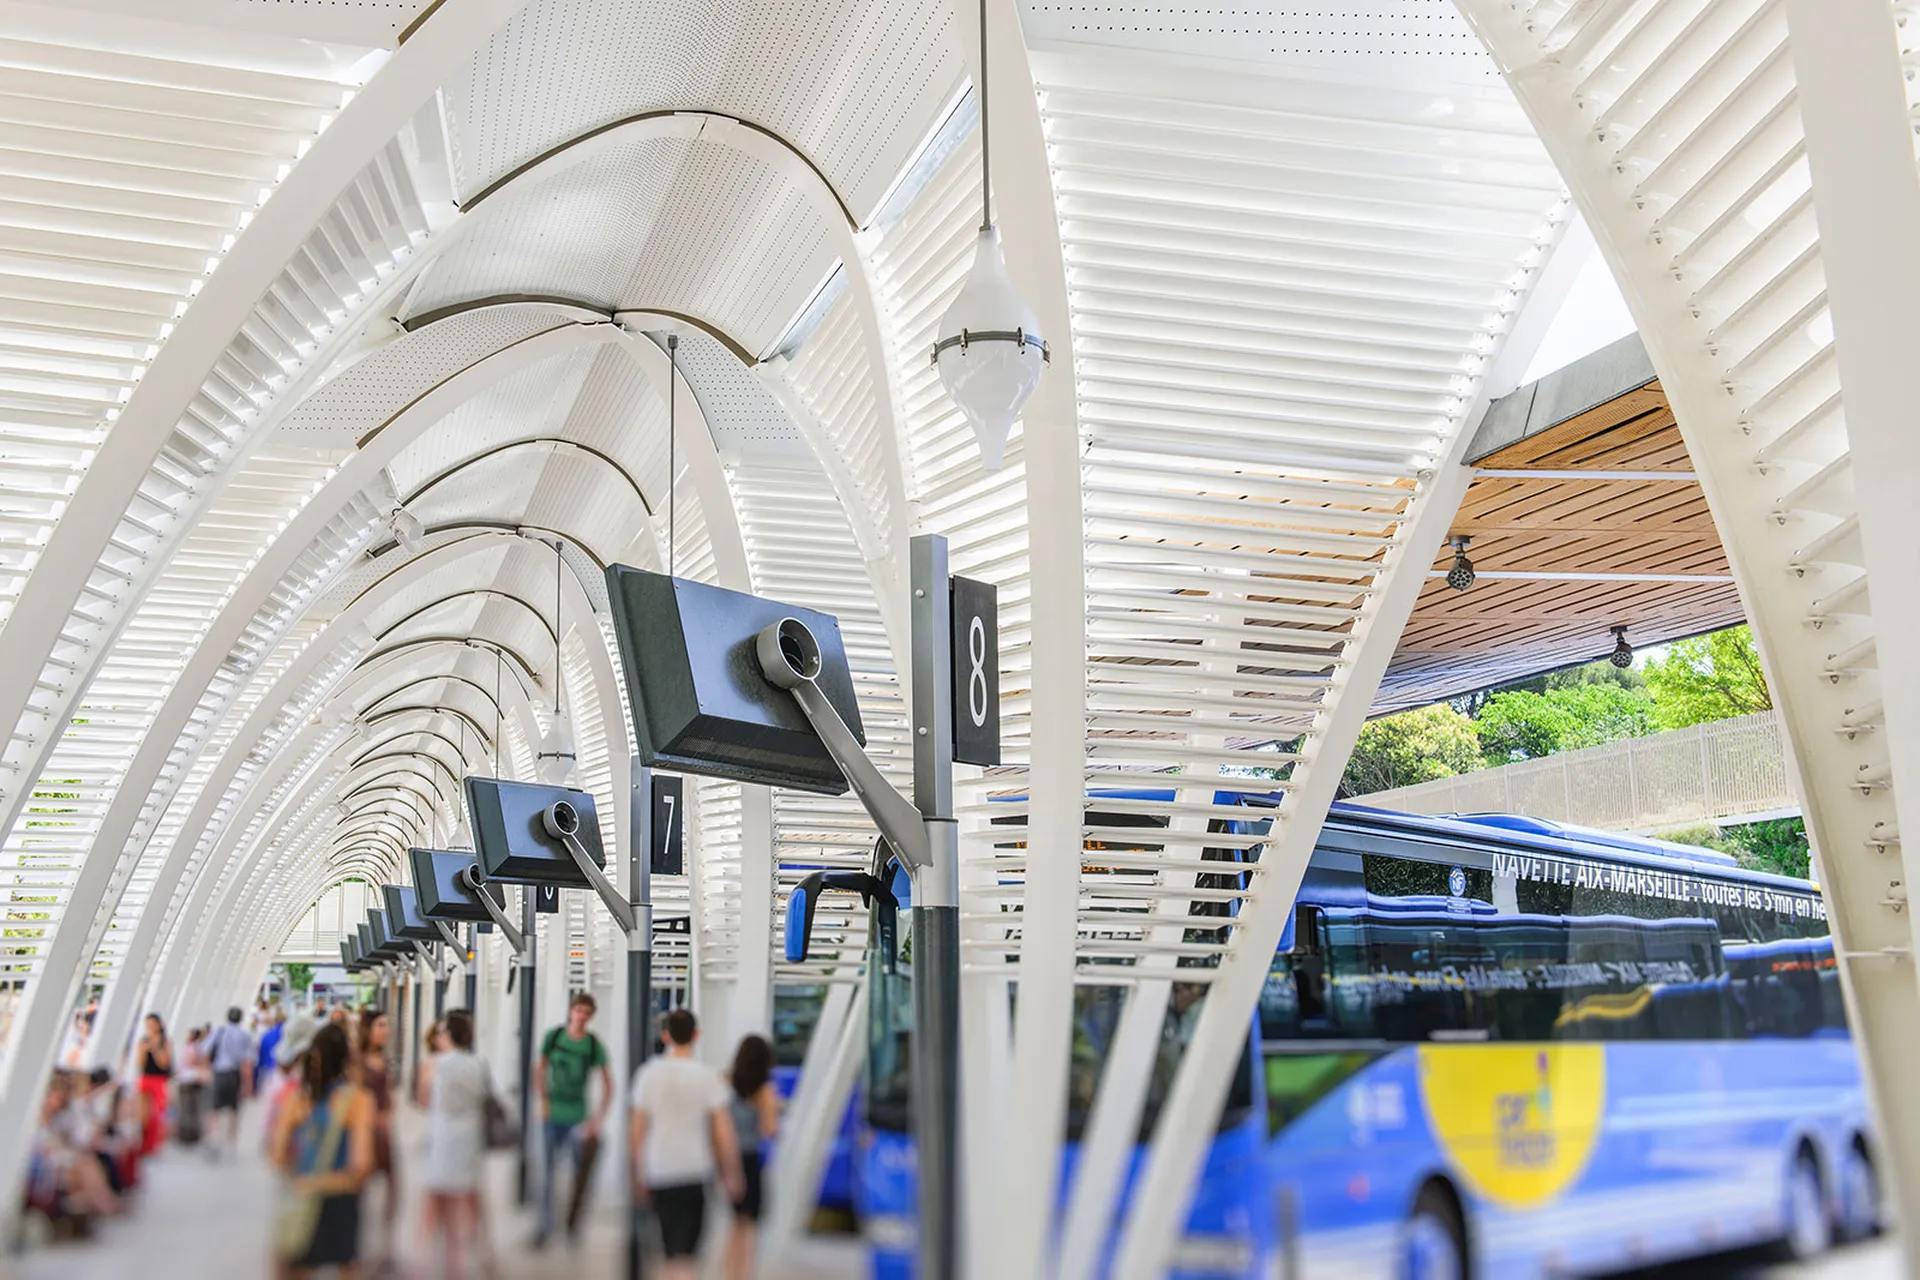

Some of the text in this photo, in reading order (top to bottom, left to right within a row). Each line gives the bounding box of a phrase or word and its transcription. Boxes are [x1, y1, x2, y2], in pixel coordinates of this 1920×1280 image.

[969, 615, 988, 727] 8
[663, 795, 675, 854] 7
[1492, 849, 1571, 885] NAVETTE
[1574, 859, 1690, 902] AIX-MARSEILLE
[1700, 880, 1742, 907] toutes
[1744, 884, 1762, 910] les
[1796, 898, 1810, 917] en
[1811, 895, 1829, 921] he
